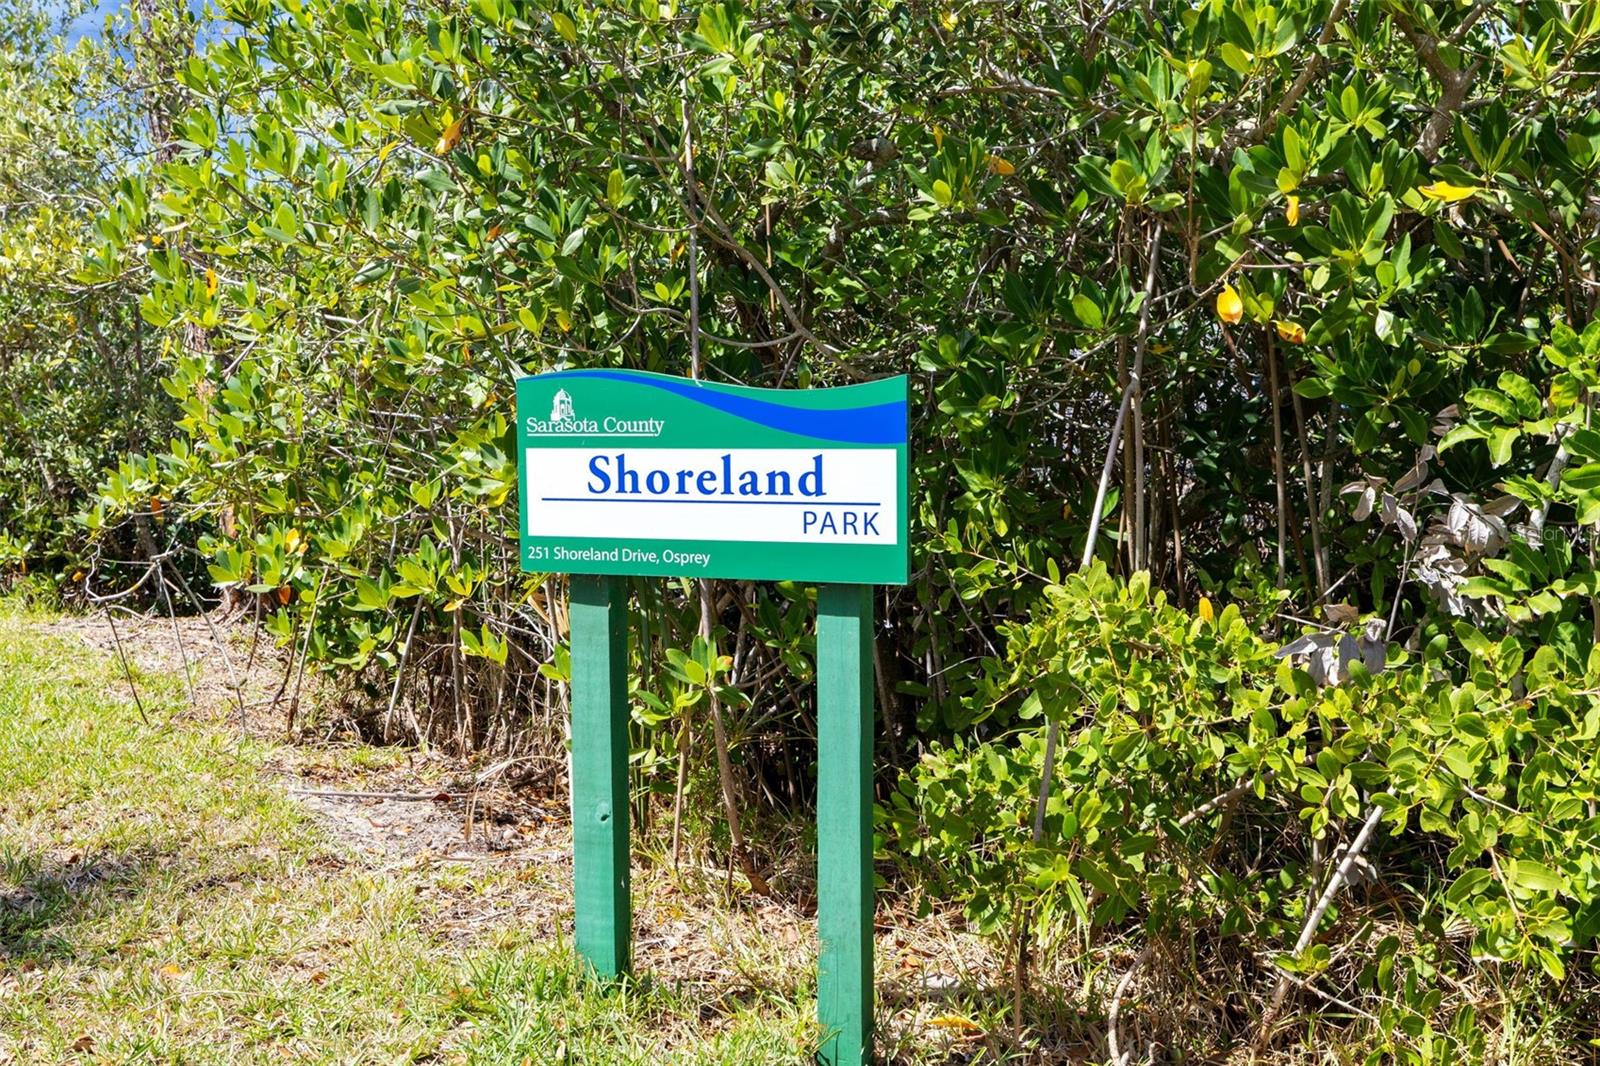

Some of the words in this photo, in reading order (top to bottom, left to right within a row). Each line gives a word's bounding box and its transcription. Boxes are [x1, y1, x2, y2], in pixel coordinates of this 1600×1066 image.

[526, 416, 599, 433] Sarasota
[603, 416, 665, 437] County
[587, 453, 827, 498] Shoreland
[803, 510, 880, 536] PARK
[527, 546, 550, 560] 251
[553, 546, 619, 562] Shoreland
[622, 548, 660, 565] Drive,
[662, 549, 711, 568] Osprey
